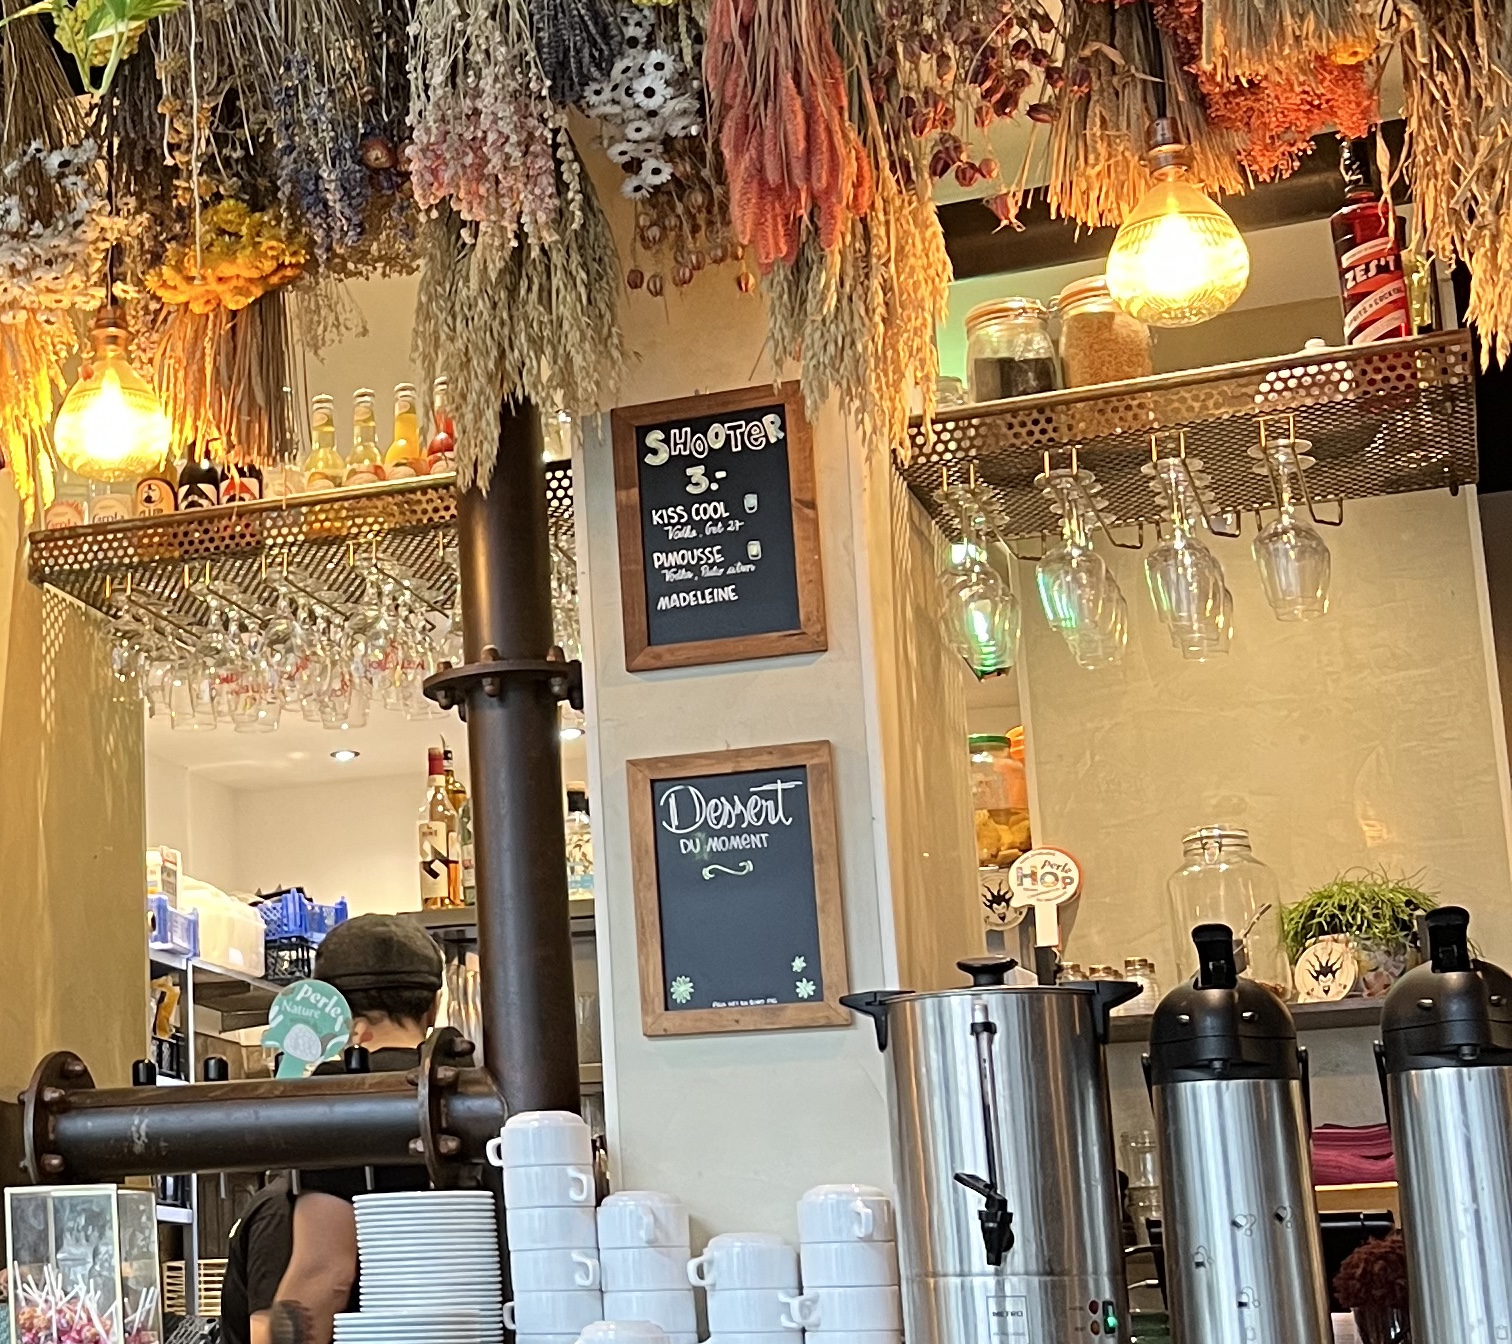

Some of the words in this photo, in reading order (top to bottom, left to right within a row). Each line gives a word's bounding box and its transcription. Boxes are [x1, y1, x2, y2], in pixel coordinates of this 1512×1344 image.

[1345, 256, 1395, 290] ZES'T
[644, 413, 785, 466] SHOOTER
[652, 505, 688, 525] KISS
[692, 501, 730, 521] COOL
[705, 521, 725, 535] Get
[657, 584, 739, 610] MADELEINE
[659, 779, 803, 834] Dessert
[679, 838, 701, 854] DU
[706, 833, 769, 852] MOMENT
[281, 999, 321, 1019] Nature
